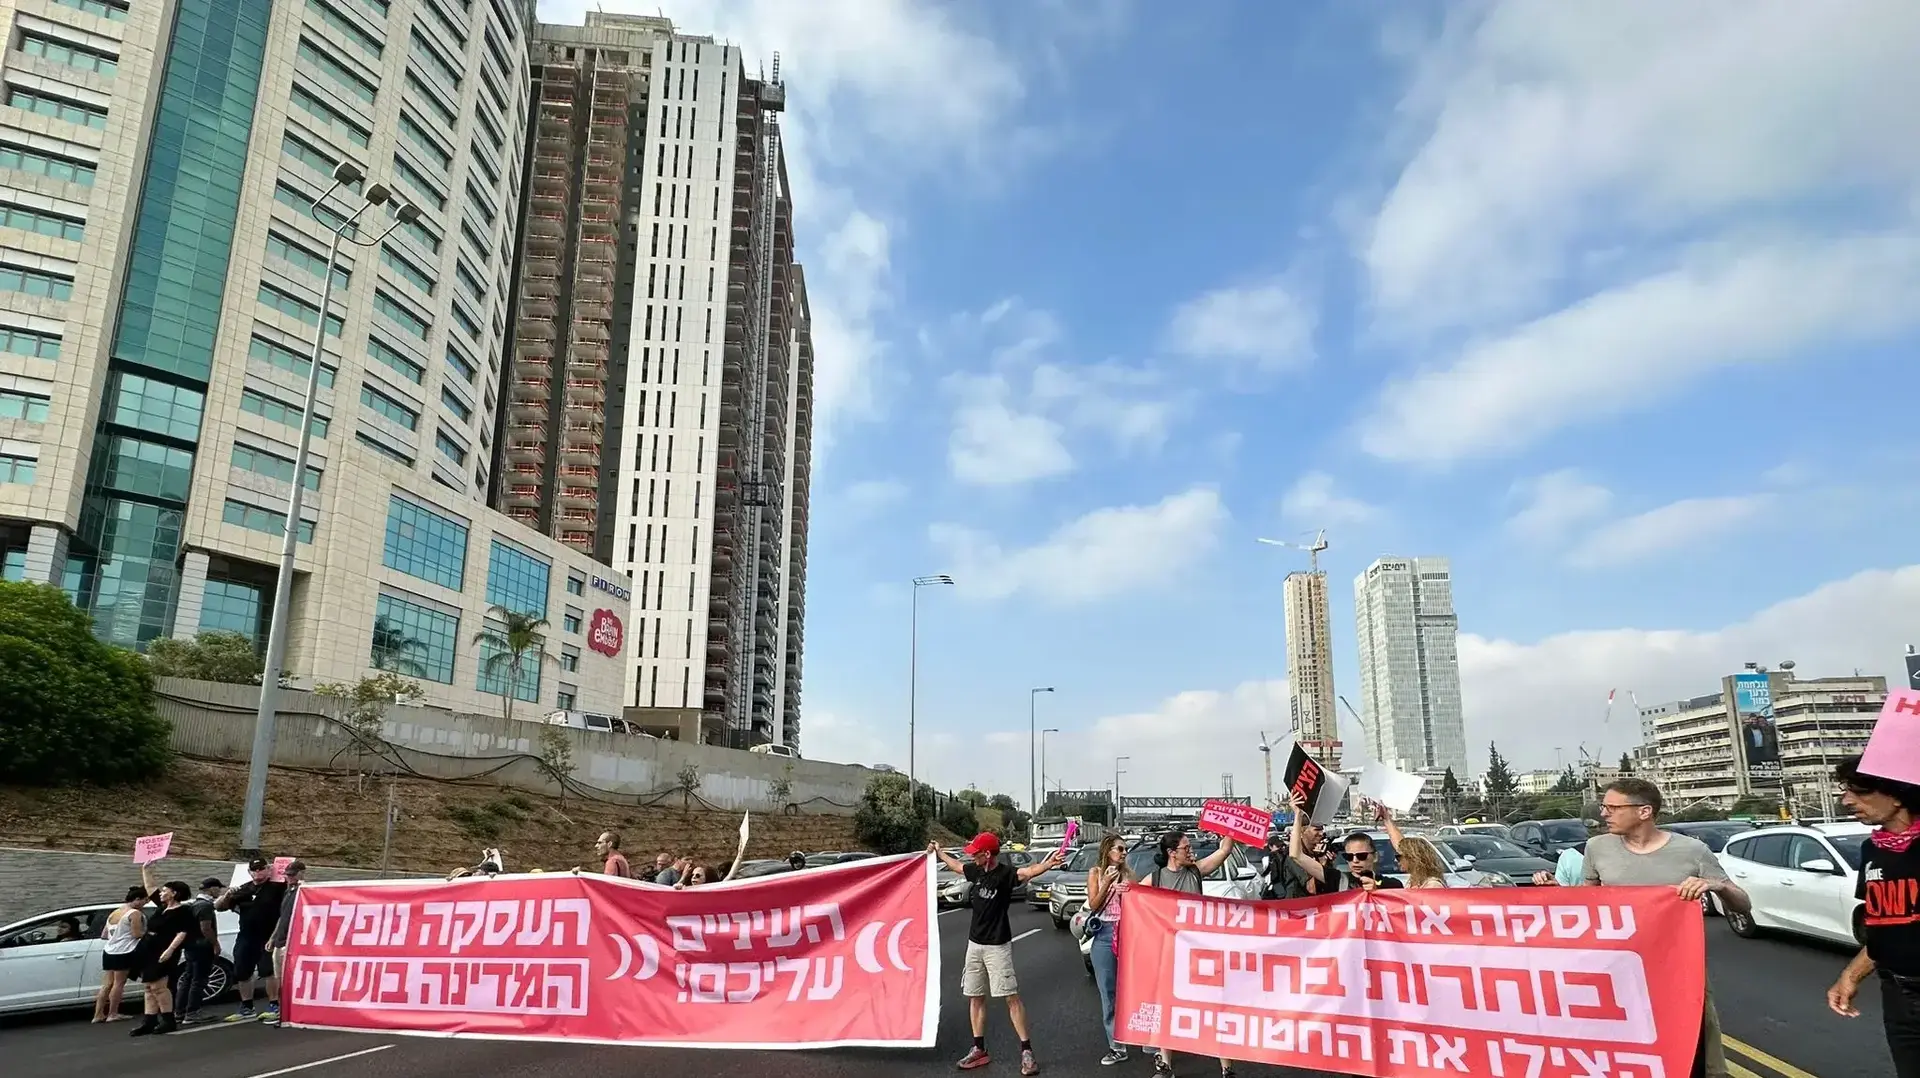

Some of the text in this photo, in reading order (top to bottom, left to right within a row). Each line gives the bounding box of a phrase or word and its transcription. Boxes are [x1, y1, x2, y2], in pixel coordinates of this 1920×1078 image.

[593, 577, 630, 600] FIRON
[1292, 759, 1319, 801] הציל
[1208, 812, 1262, 835] זועק אלי
[1248, 812, 1268, 825] קול
[300, 898, 591, 954] העסקה נופלת
[666, 903, 845, 951] העיניים
[1175, 899, 1637, 943] עסקה או גזר דין מוות
[295, 960, 582, 1009] המדינה בוערת
[676, 956, 844, 1003] עליכם!
[1189, 948, 1628, 1021] בוחרות בחיים
[1170, 1006, 1373, 1062] החטופים
[1387, 1029, 1470, 1073] את
